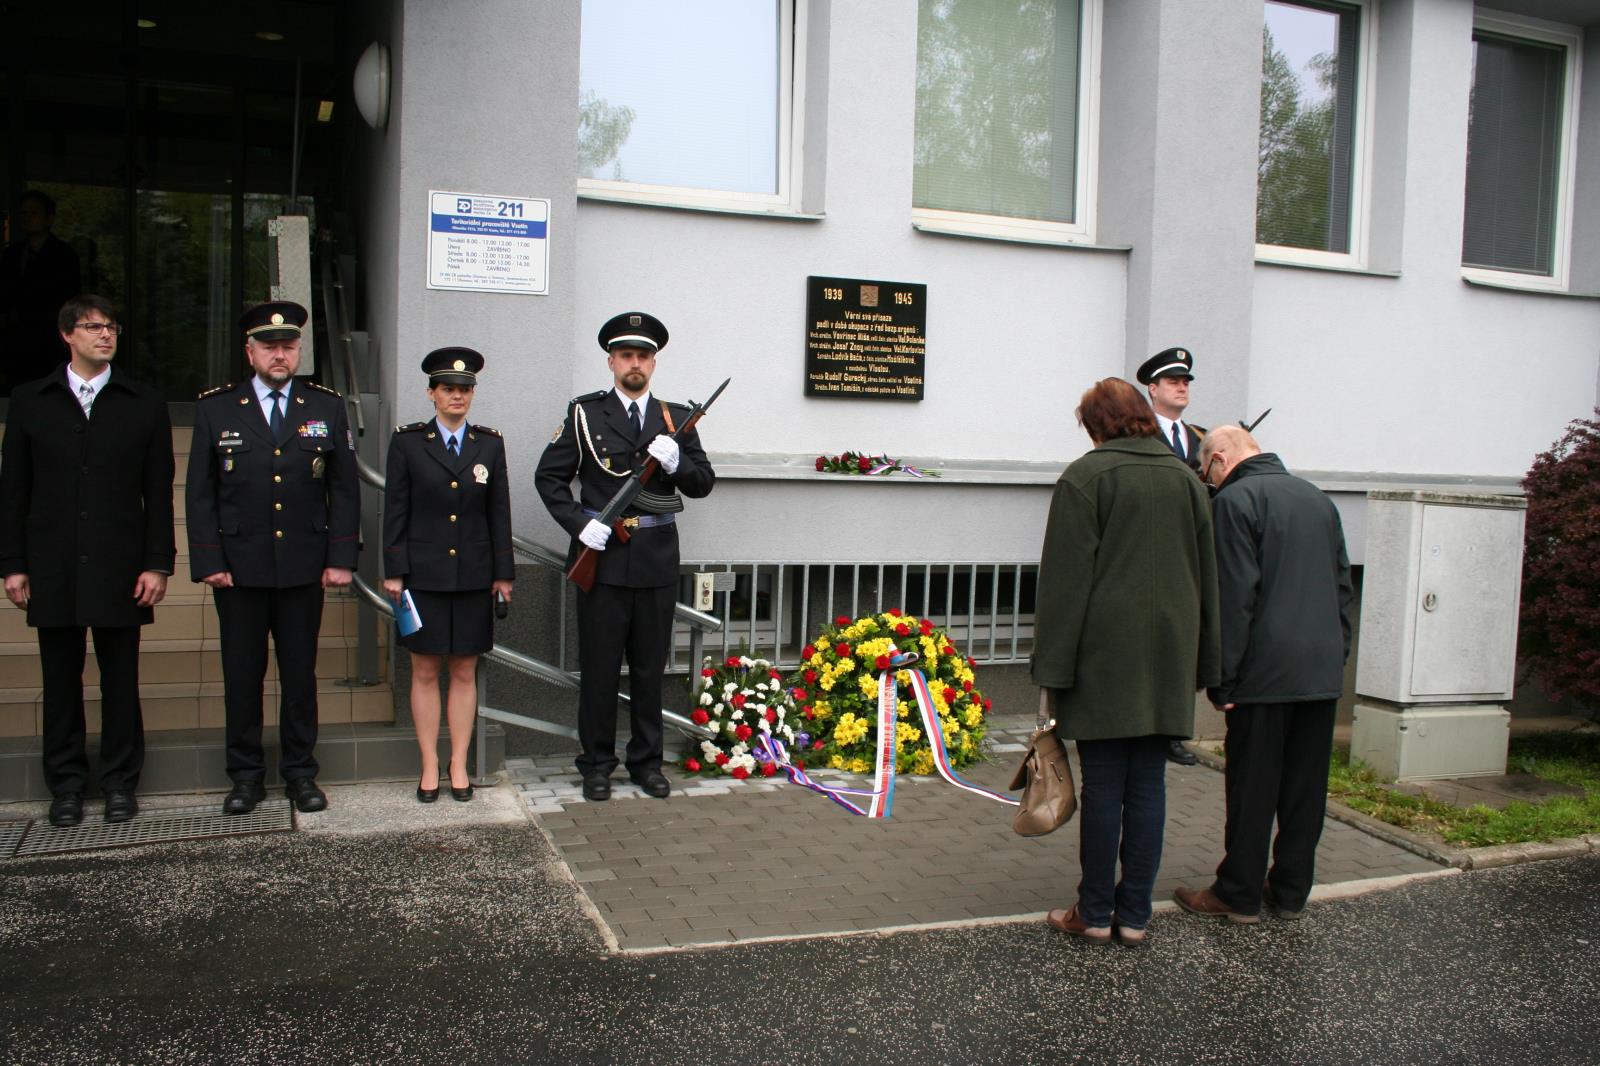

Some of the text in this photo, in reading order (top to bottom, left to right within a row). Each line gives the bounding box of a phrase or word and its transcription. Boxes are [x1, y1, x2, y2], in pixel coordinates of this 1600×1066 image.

[498, 201, 523, 217] 211
[824, 287, 913, 305] 1939 1945
[816, 320, 829, 329] padli
[834, 320, 847, 329] době
[833, 341, 849, 350] Josef
[824, 371, 842, 381] Rudolf
[828, 382, 840, 391] Ivan
